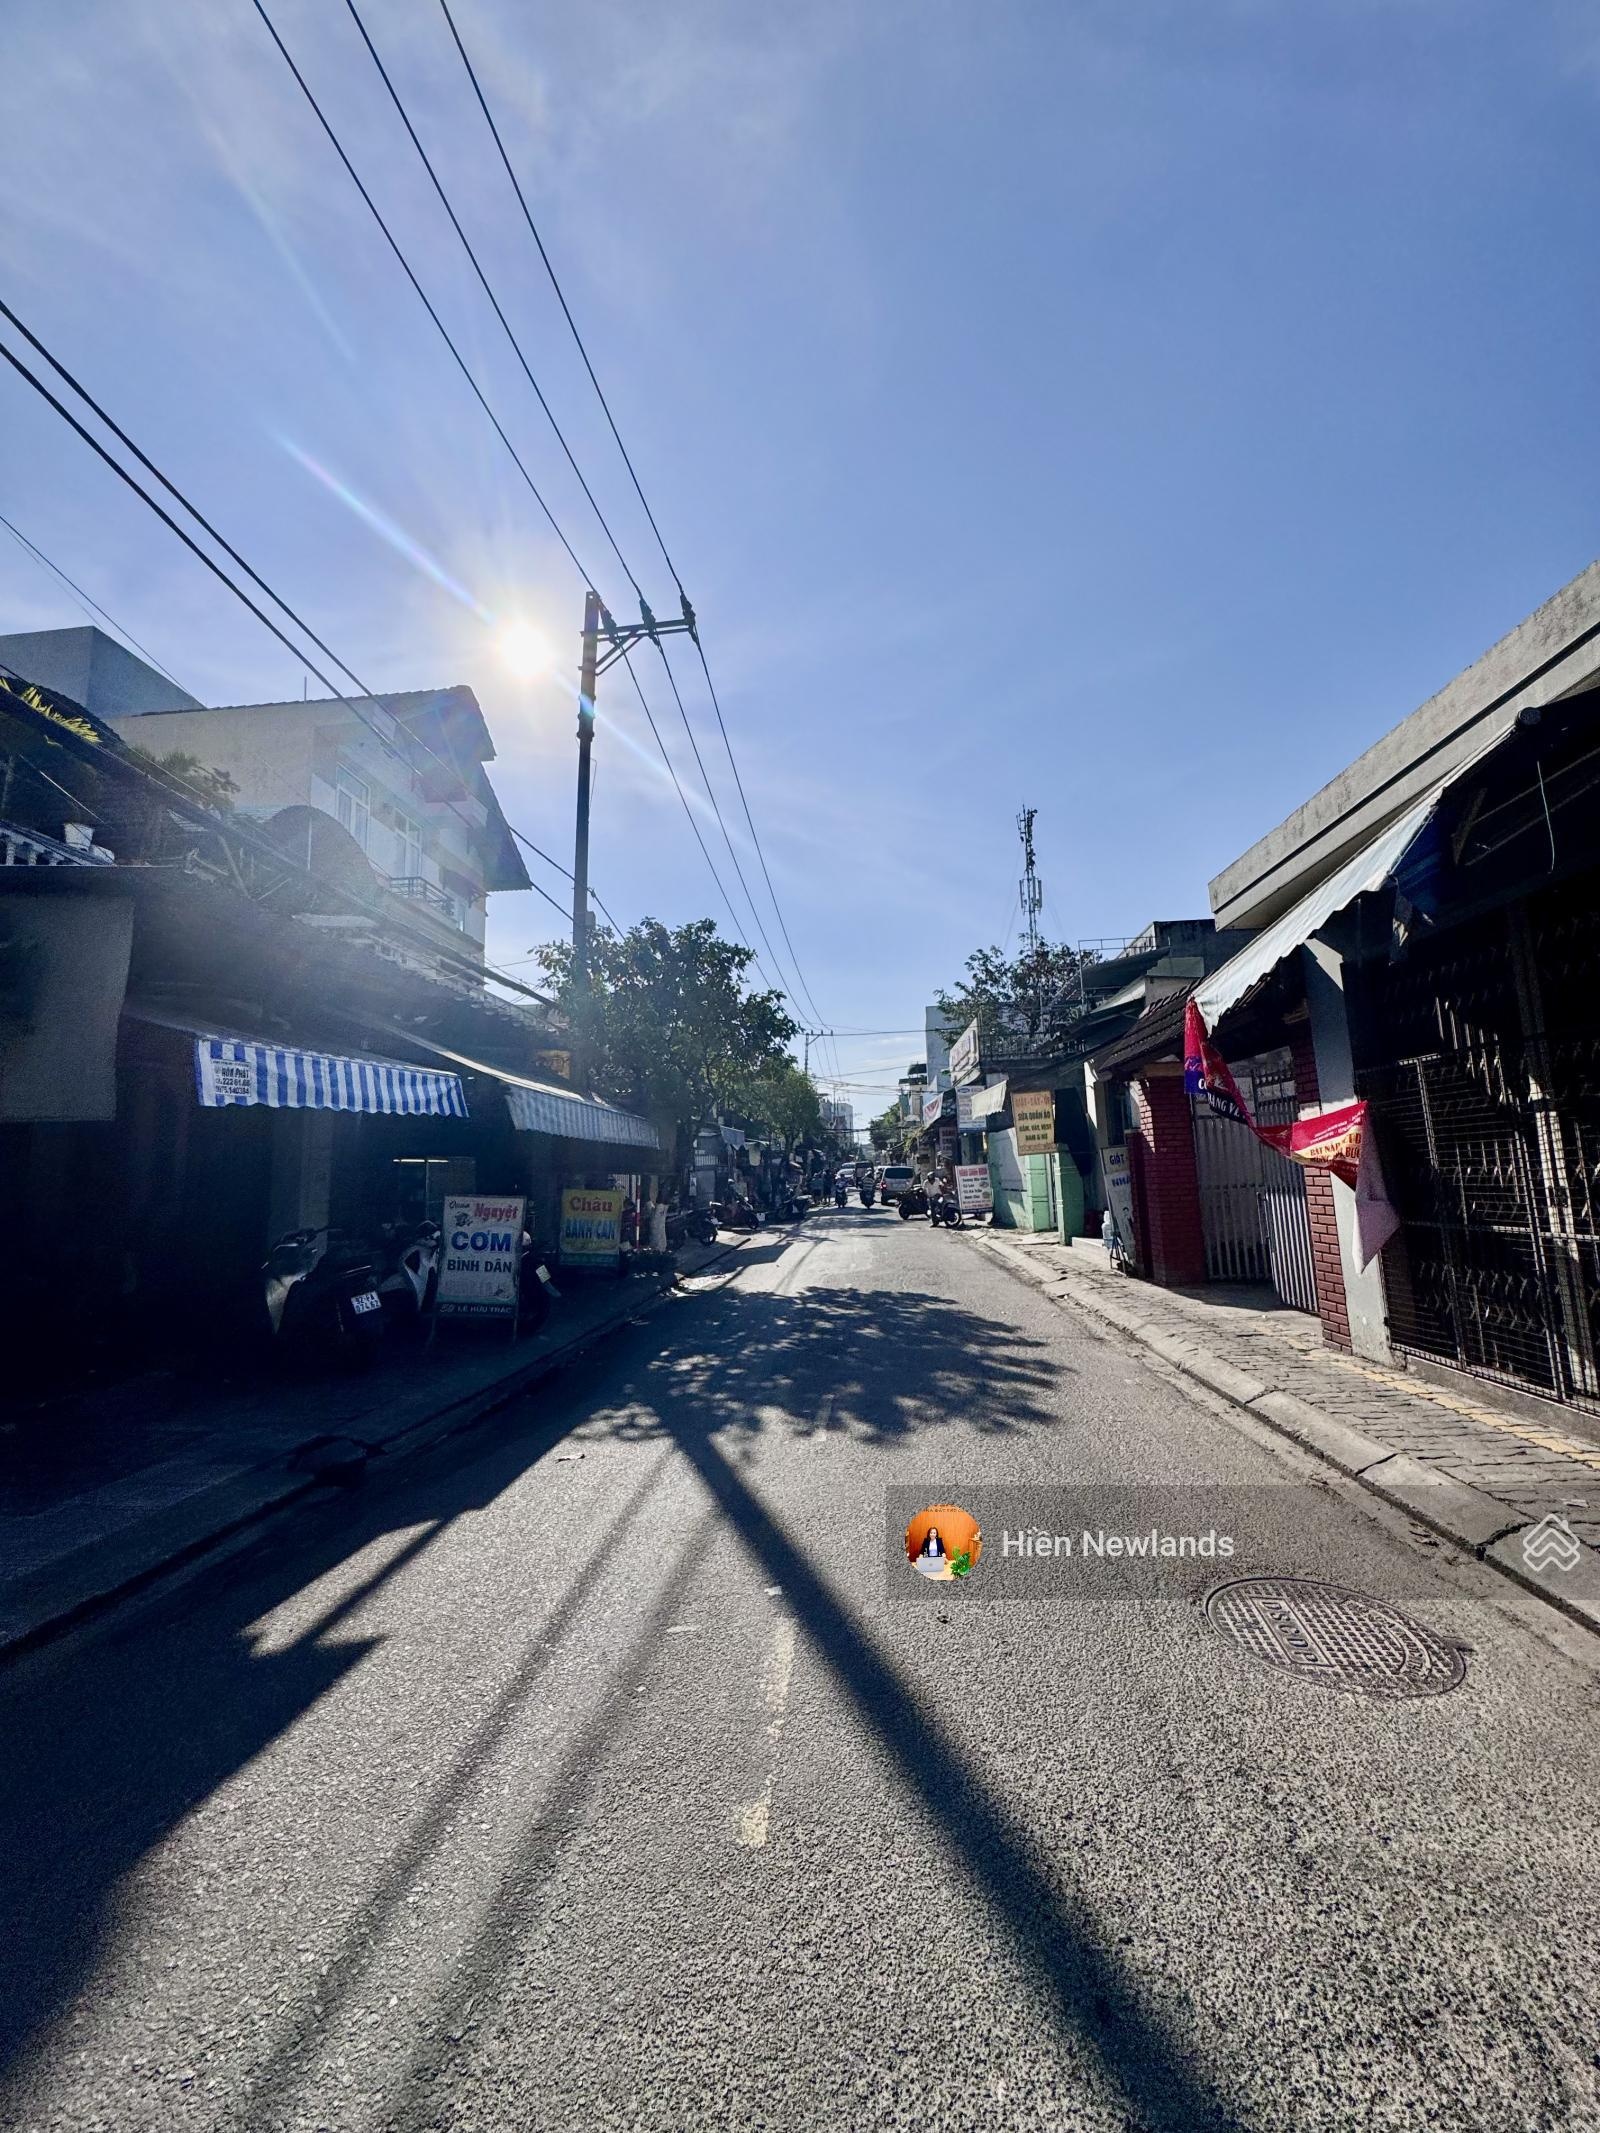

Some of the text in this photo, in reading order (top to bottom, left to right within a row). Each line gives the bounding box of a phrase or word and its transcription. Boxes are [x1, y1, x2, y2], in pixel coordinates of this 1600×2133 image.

[473, 1203, 519, 1221] Nguyệt
[570, 1196, 613, 1212] Châu
[451, 1230, 512, 1252] CƠM
[447, 1257, 513, 1273] BÌNH DÂN
[1261, 1600, 1319, 1664] DSCDP
